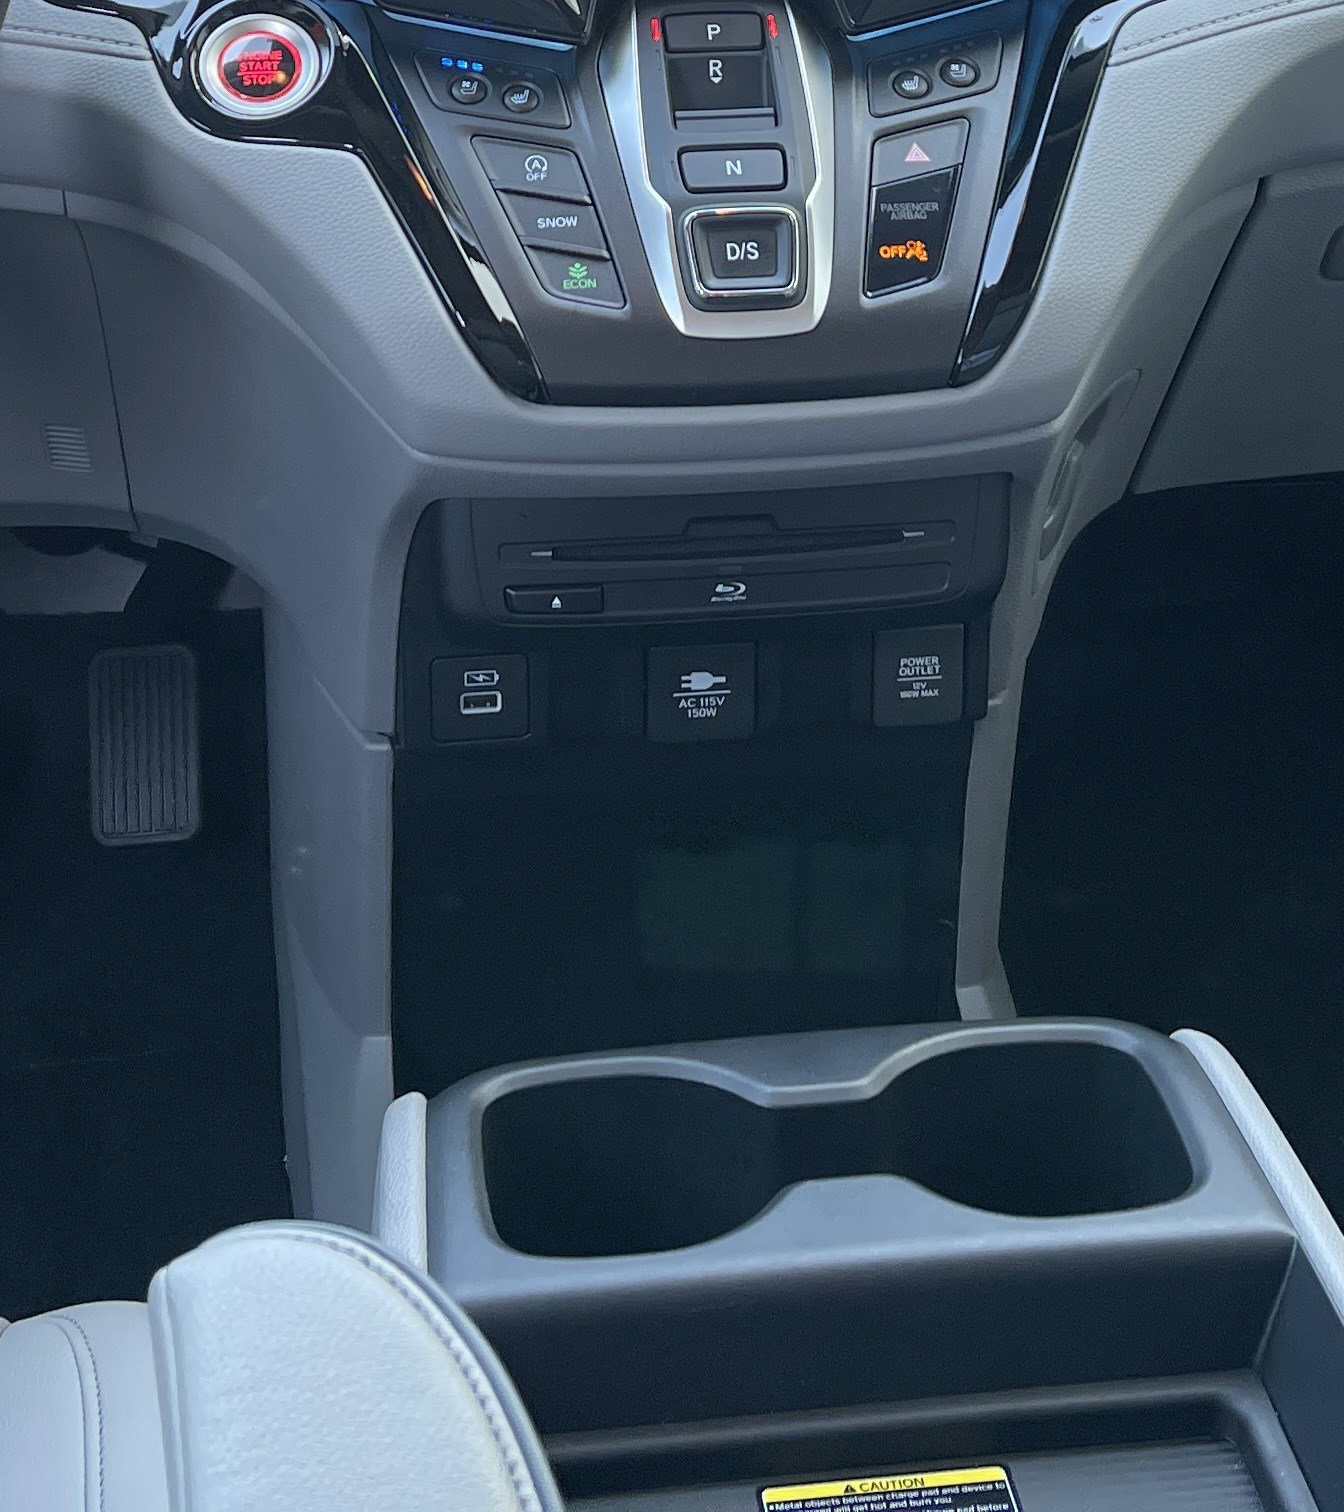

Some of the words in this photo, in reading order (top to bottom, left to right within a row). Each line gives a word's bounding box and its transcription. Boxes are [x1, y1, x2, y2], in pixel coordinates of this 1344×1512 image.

[706, 24, 721, 40] P
[239, 60, 280, 72] START
[709, 60, 723, 77] R
[725, 160, 743, 175] N
[526, 172, 548, 181] OFF
[880, 201, 939, 212] PASSENGER
[537, 216, 578, 228] SNOW
[726, 242, 759, 261] D/S
[879, 245, 906, 258] OFF
[563, 278, 597, 289] ECON
[900, 656, 939, 666] POWER
[899, 665, 940, 676] OUTLET
[679, 698, 696, 708] AC
[700, 696, 725, 707] 115V
[688, 707, 717, 718] 150W
[859, 1478, 924, 1492] CAUTION
[842, 1493, 884, 1504] between
[941, 1486, 960, 1494] and
